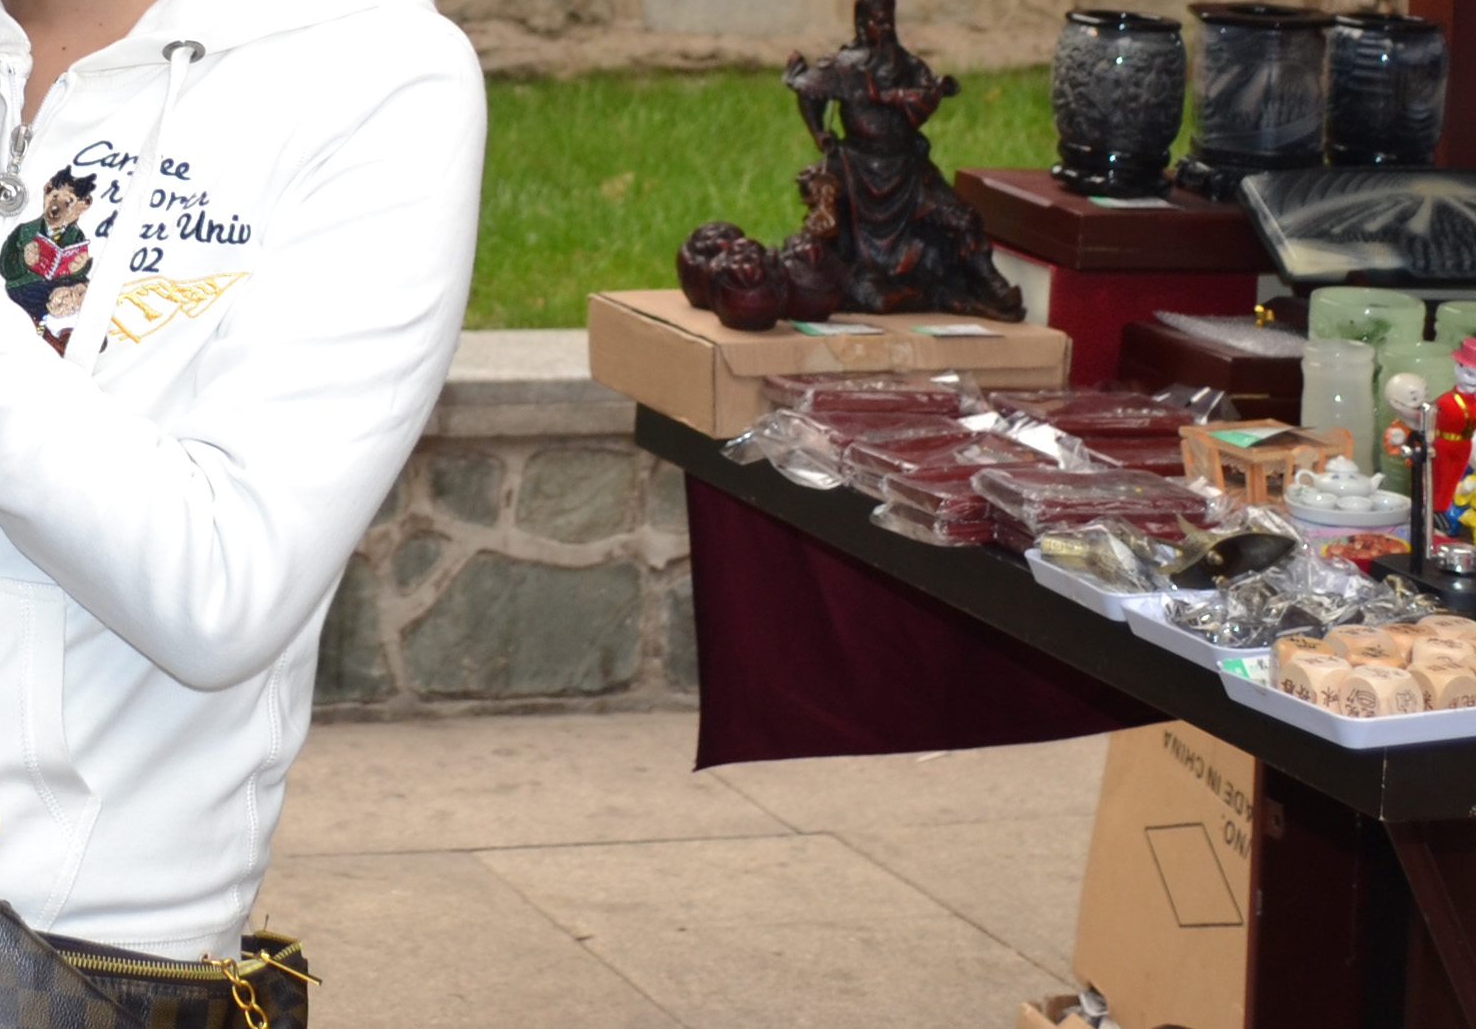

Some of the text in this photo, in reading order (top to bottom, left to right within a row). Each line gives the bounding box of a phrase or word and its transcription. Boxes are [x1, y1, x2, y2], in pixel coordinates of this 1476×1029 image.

[176, 209, 252, 245] Univ
[129, 246, 164, 273] 02
[1164, 730, 1205, 779] CHINA
[1206, 765, 1223, 797] IN
